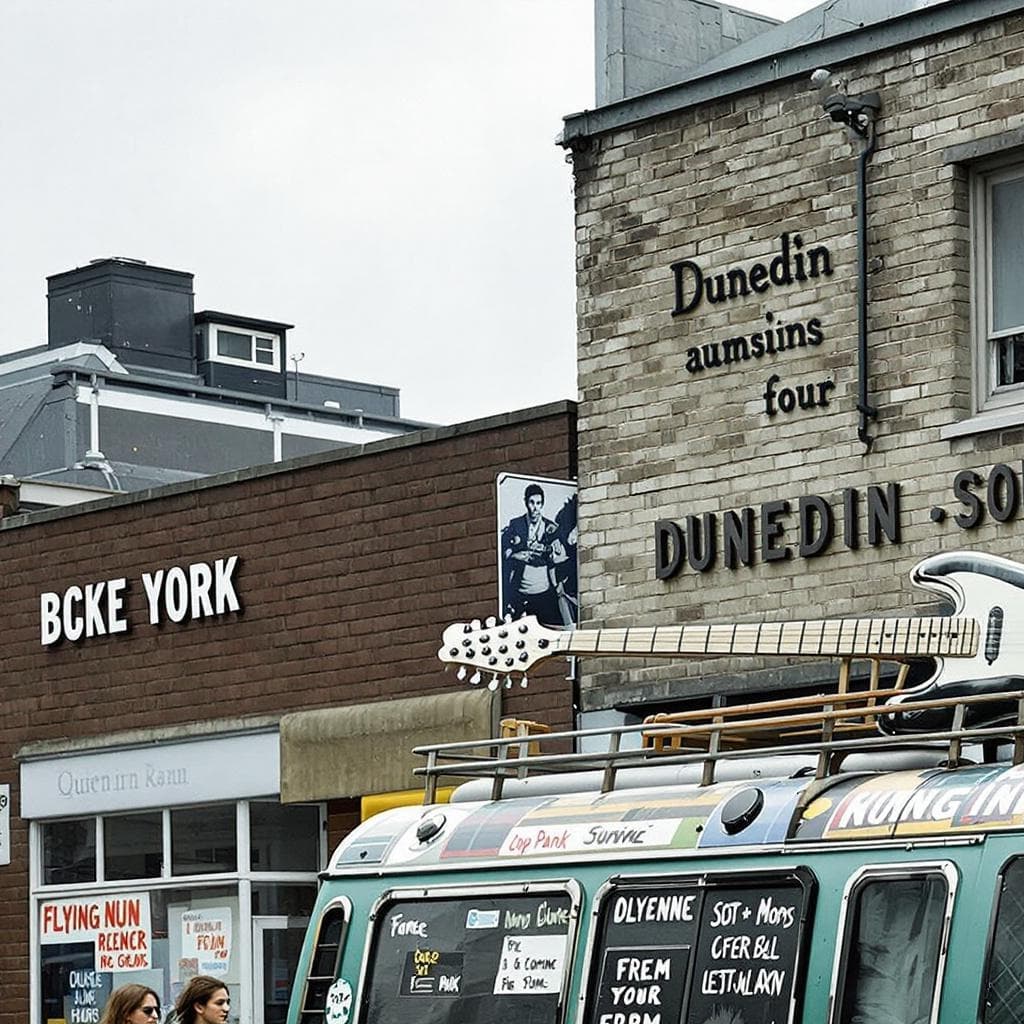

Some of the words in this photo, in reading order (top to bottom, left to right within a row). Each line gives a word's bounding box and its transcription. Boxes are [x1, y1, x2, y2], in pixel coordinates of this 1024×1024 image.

[670, 232, 833, 317] Dunedin
[762, 372, 836, 416] four
[654, 482, 901, 579] DUNEDIN
[141, 555, 241, 625] YORK
[43, 903, 100, 934] FLYING
[104, 899, 141, 928] NUN
[616, 957, 671, 982] FREM
[609, 984, 662, 1005] YOUR
